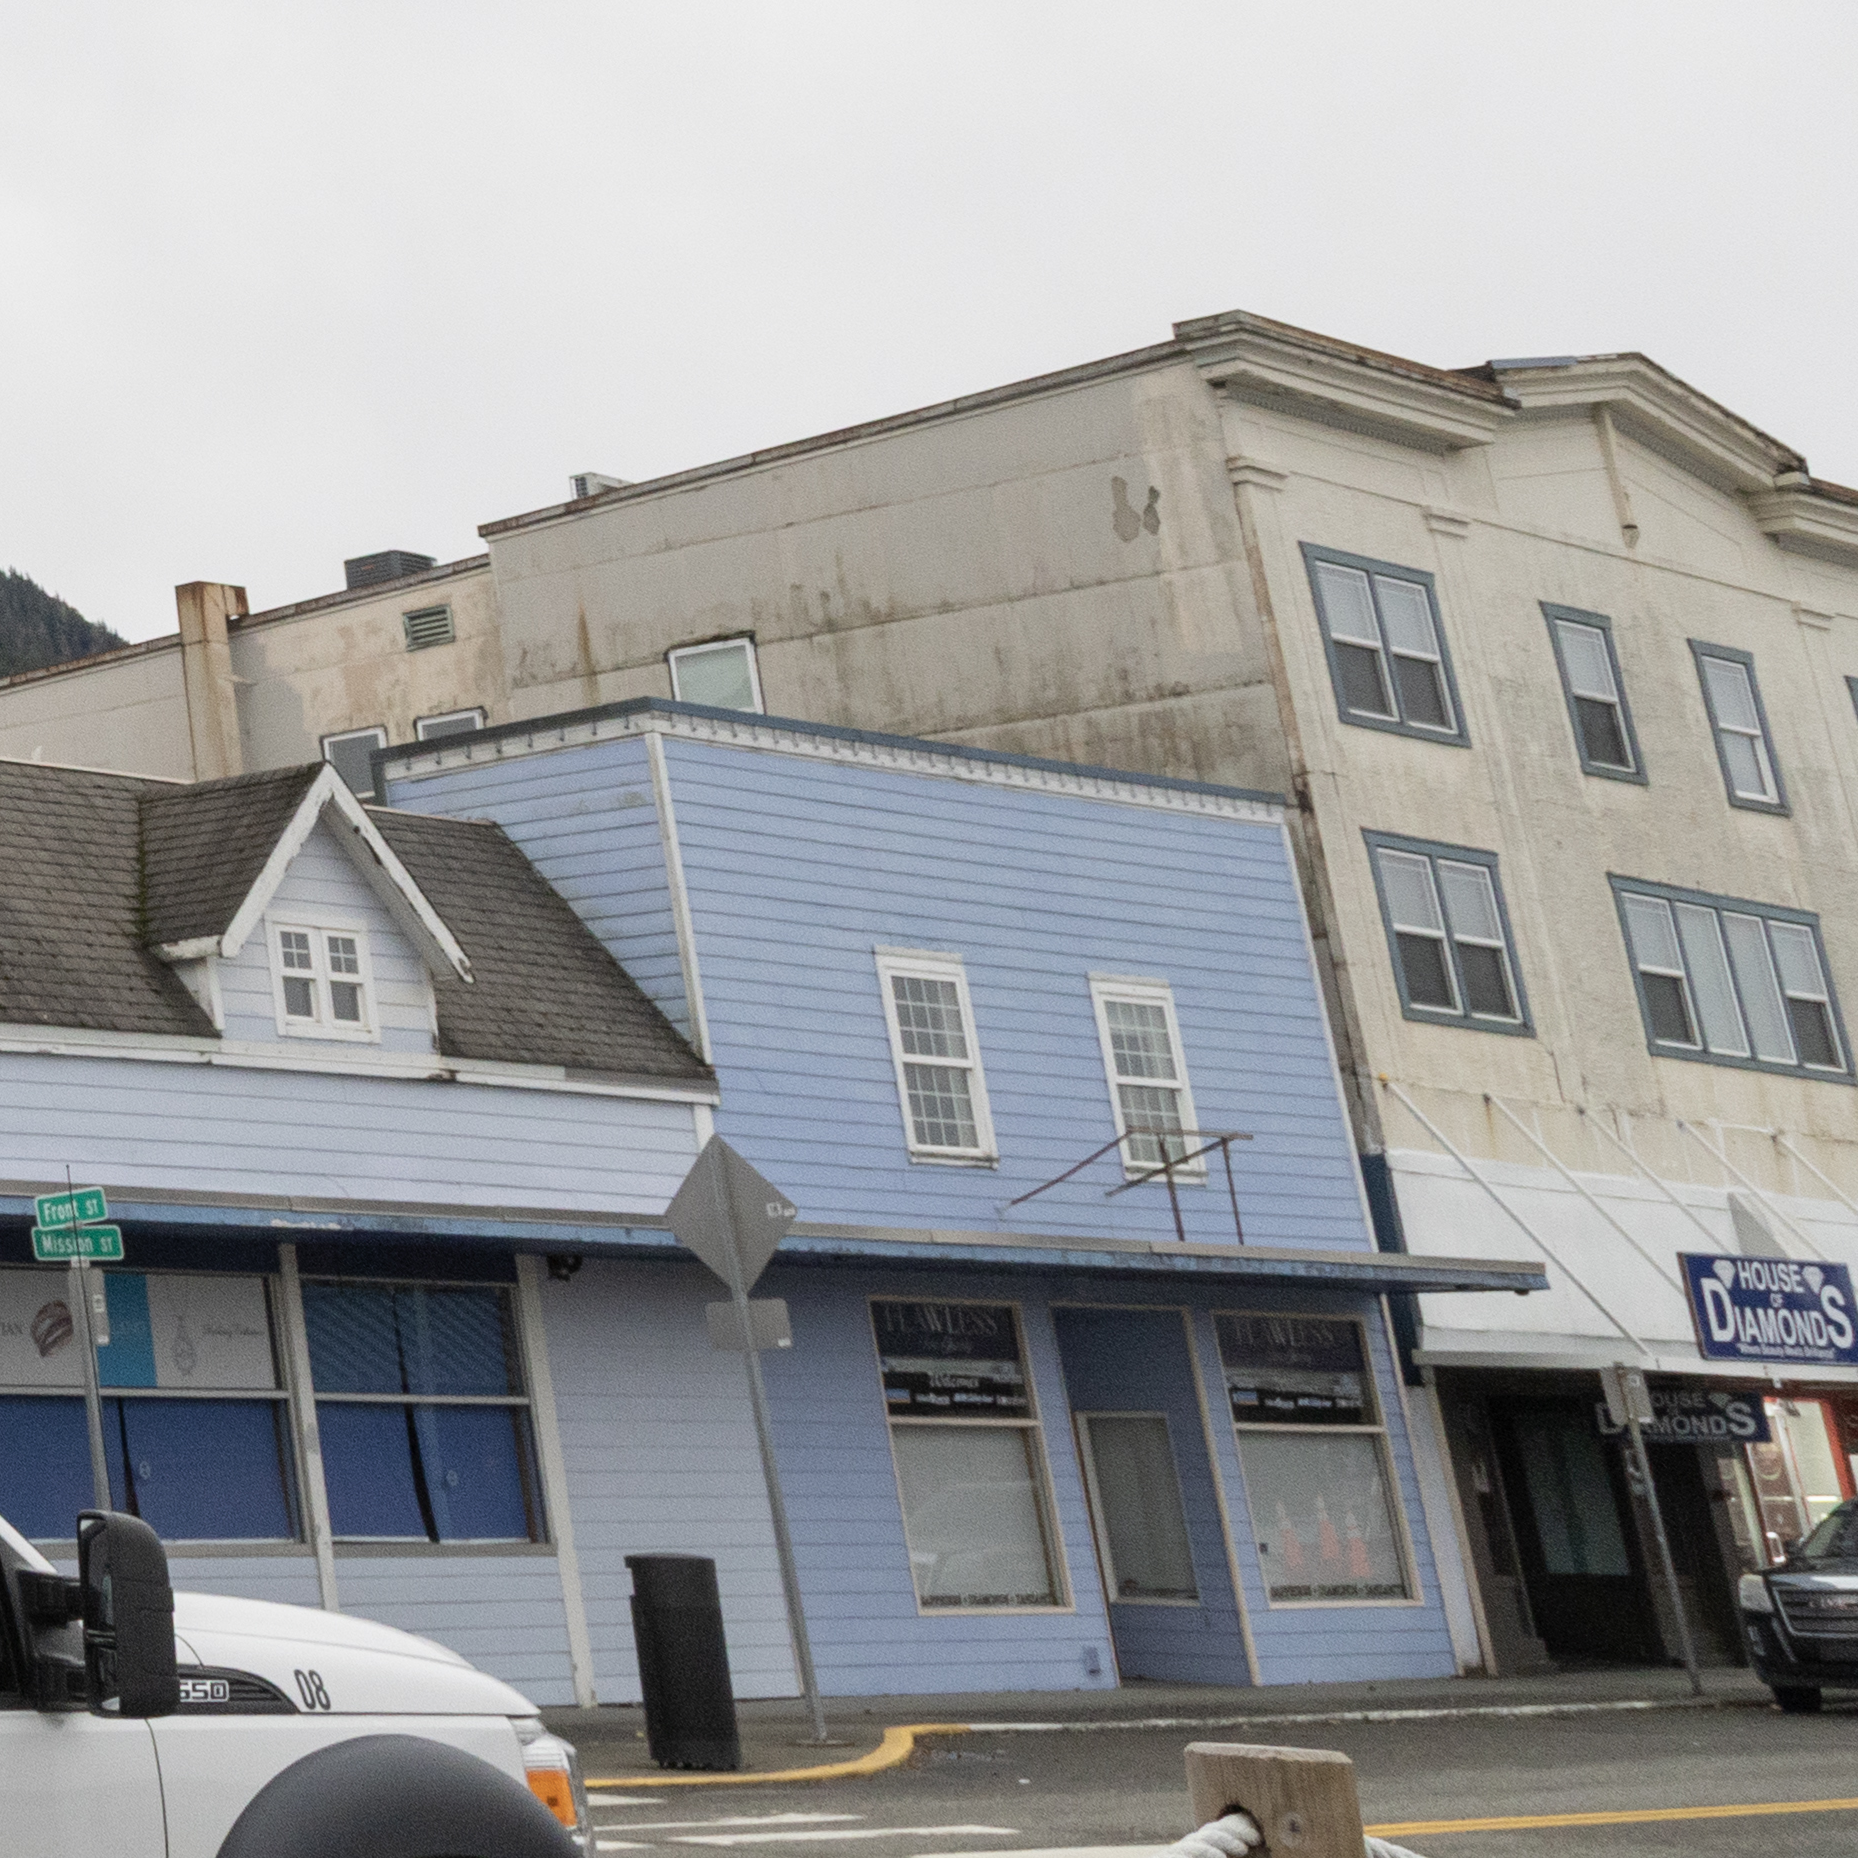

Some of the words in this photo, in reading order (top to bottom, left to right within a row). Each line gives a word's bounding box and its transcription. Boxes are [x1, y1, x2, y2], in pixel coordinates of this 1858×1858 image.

[43, 1198, 80, 1222] Front
[41, 1234, 94, 1254] Mission
[1736, 1260, 1806, 1293] HOUSE
[1700, 1276, 1855, 1350] DIAMONDS
[1770, 1292, 1784, 1308] OF
[884, 1304, 999, 1335] FLAWLESS
[1648, 1391, 1706, 1409] OUSE
[293, 1668, 332, 1711] 08
